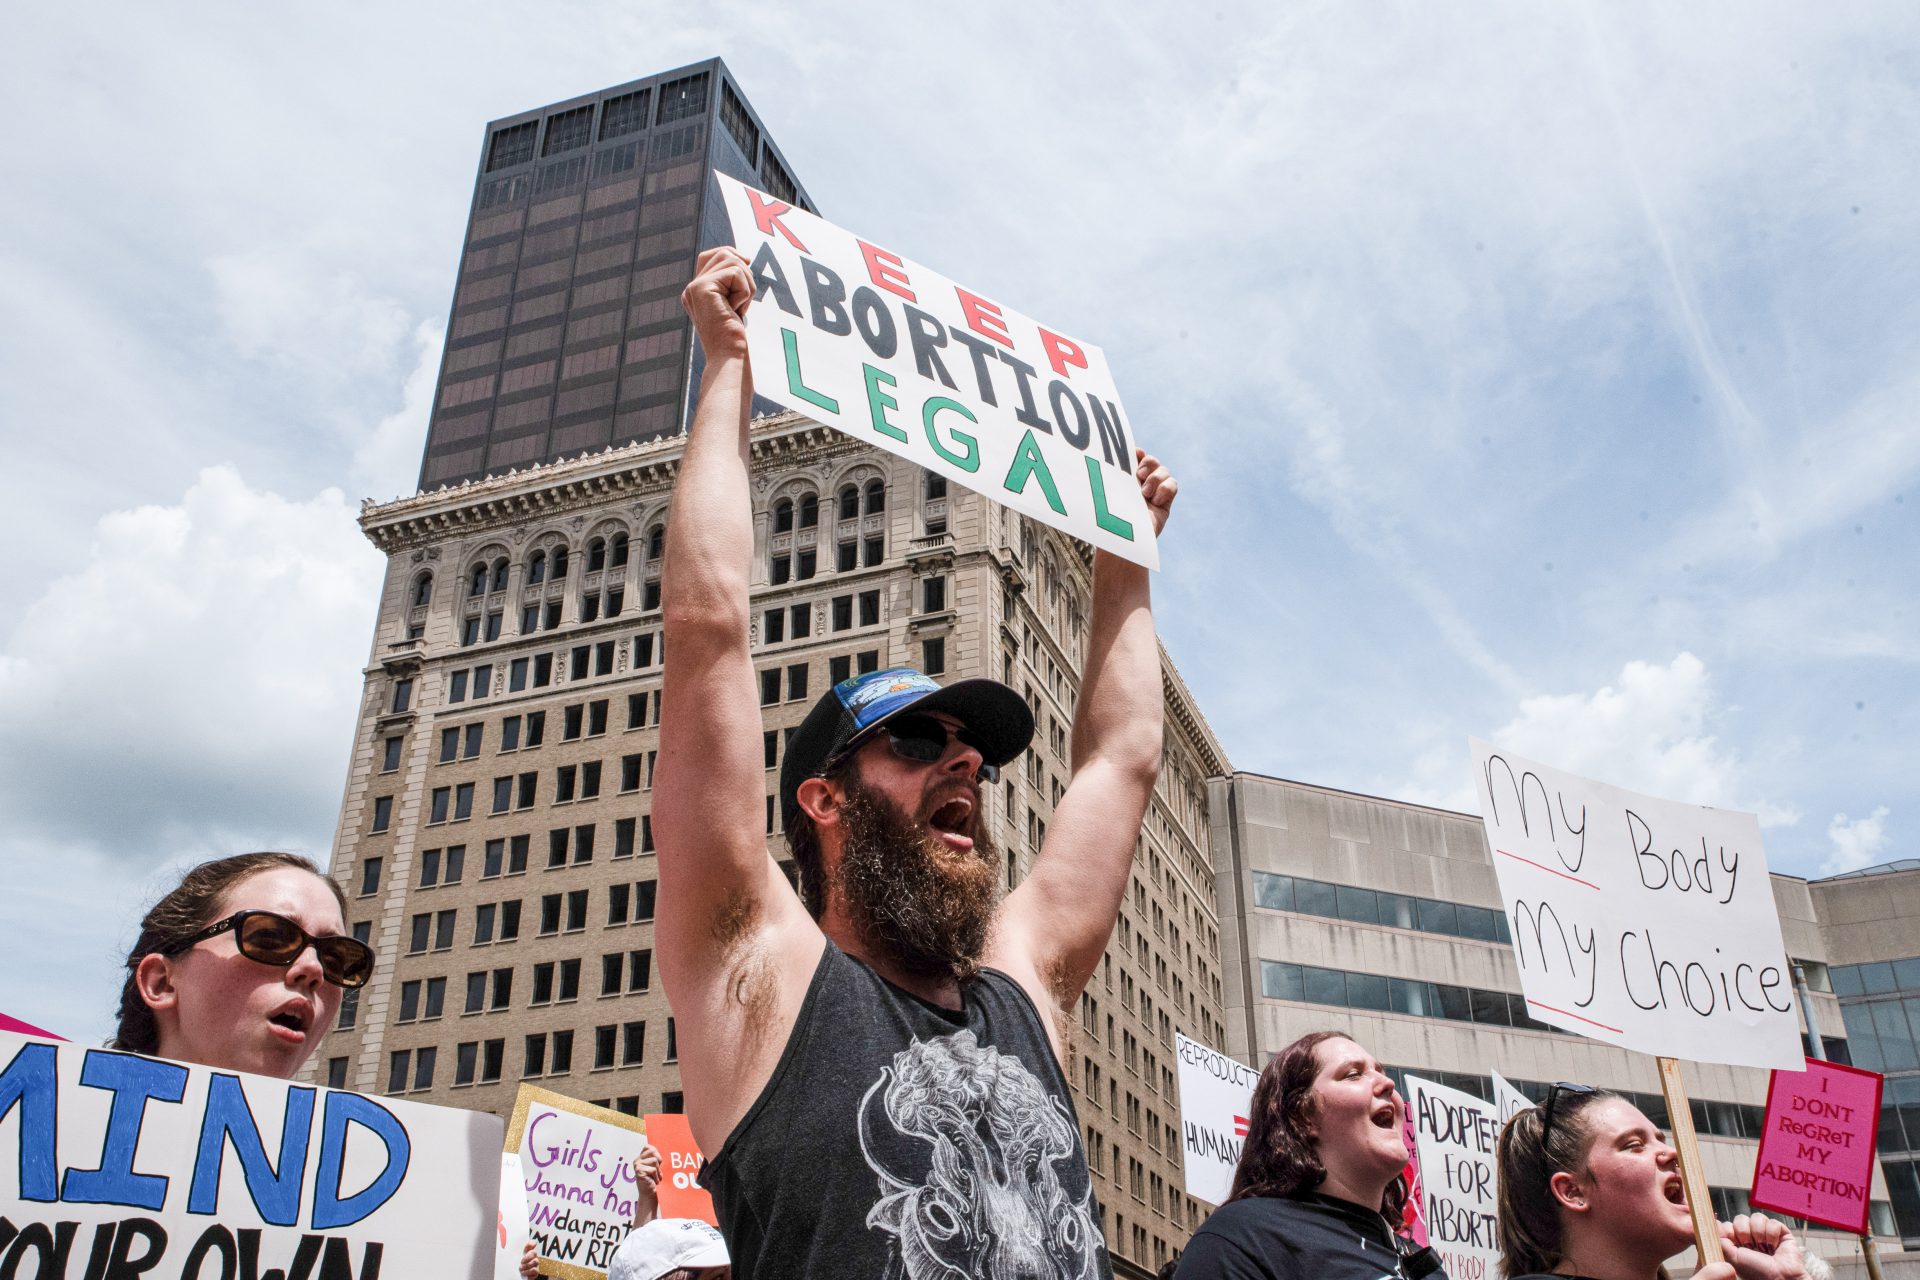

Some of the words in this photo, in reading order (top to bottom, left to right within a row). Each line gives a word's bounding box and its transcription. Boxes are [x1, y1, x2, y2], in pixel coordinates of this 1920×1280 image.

[744, 186, 1088, 378] KEEP
[749, 241, 1131, 475] ABORTION
[781, 327, 1134, 541] LEGAL
[1484, 754, 1585, 872] My
[1626, 809, 1738, 904] Body
[1514, 899, 1596, 1008] My
[1621, 929, 1790, 1016] Choice
[1792, 1094, 1854, 1123] DONT
[1821, 1078, 1828, 1093] I
[528, 1112, 602, 1173] Girls
[1184, 1120, 1240, 1166] HUMAN
[1796, 1142, 1832, 1165] MY
[1444, 1153, 1493, 1204] FOR
[1760, 1162, 1865, 1202] ABORTION
[0, 1216, 168, 1280] OUR
